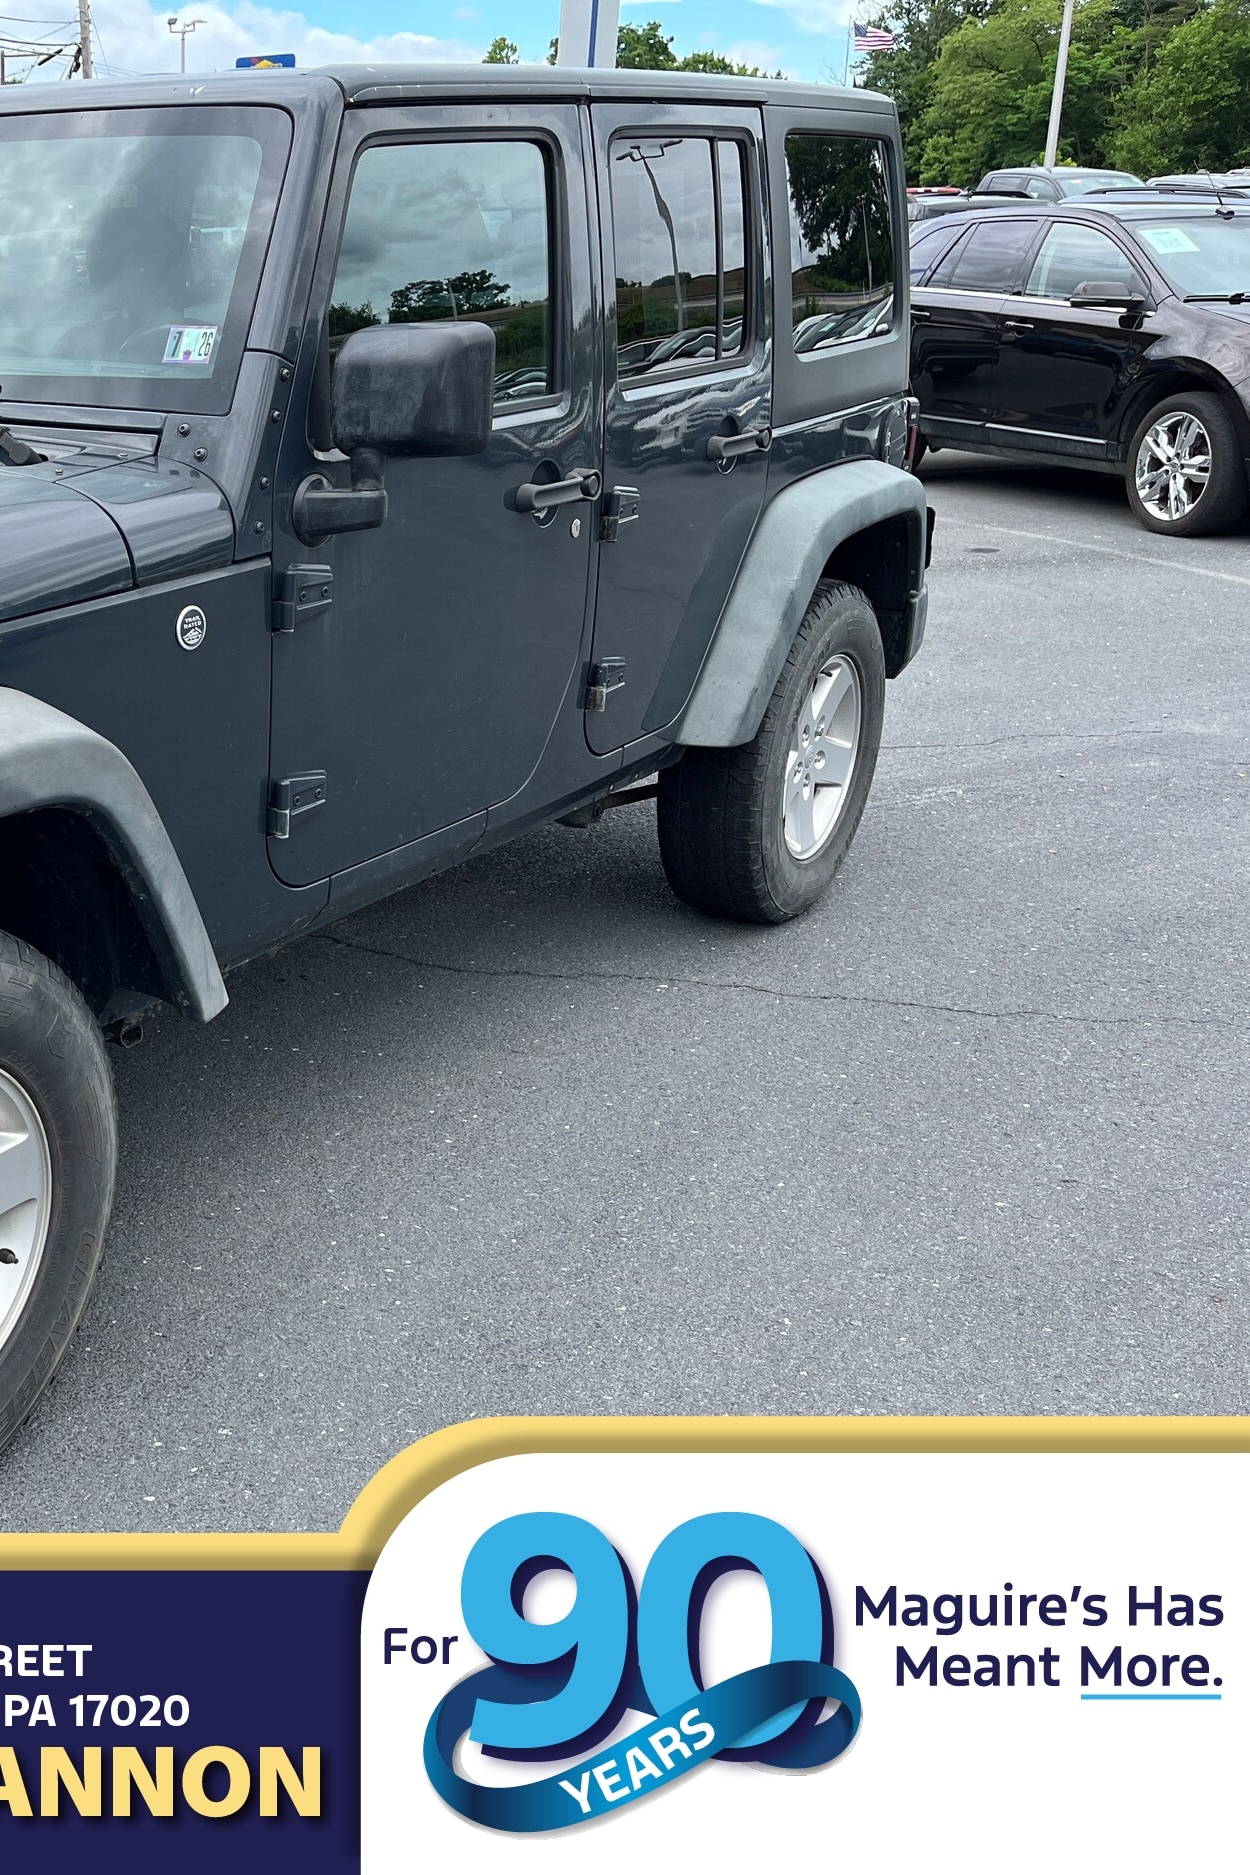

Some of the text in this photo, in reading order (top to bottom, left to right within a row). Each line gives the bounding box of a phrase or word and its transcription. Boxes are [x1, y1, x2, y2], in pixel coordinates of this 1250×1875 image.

[197, 331, 214, 357] 26
[184, 615, 201, 624] TRAIL
[183, 620, 203, 630] RATED
